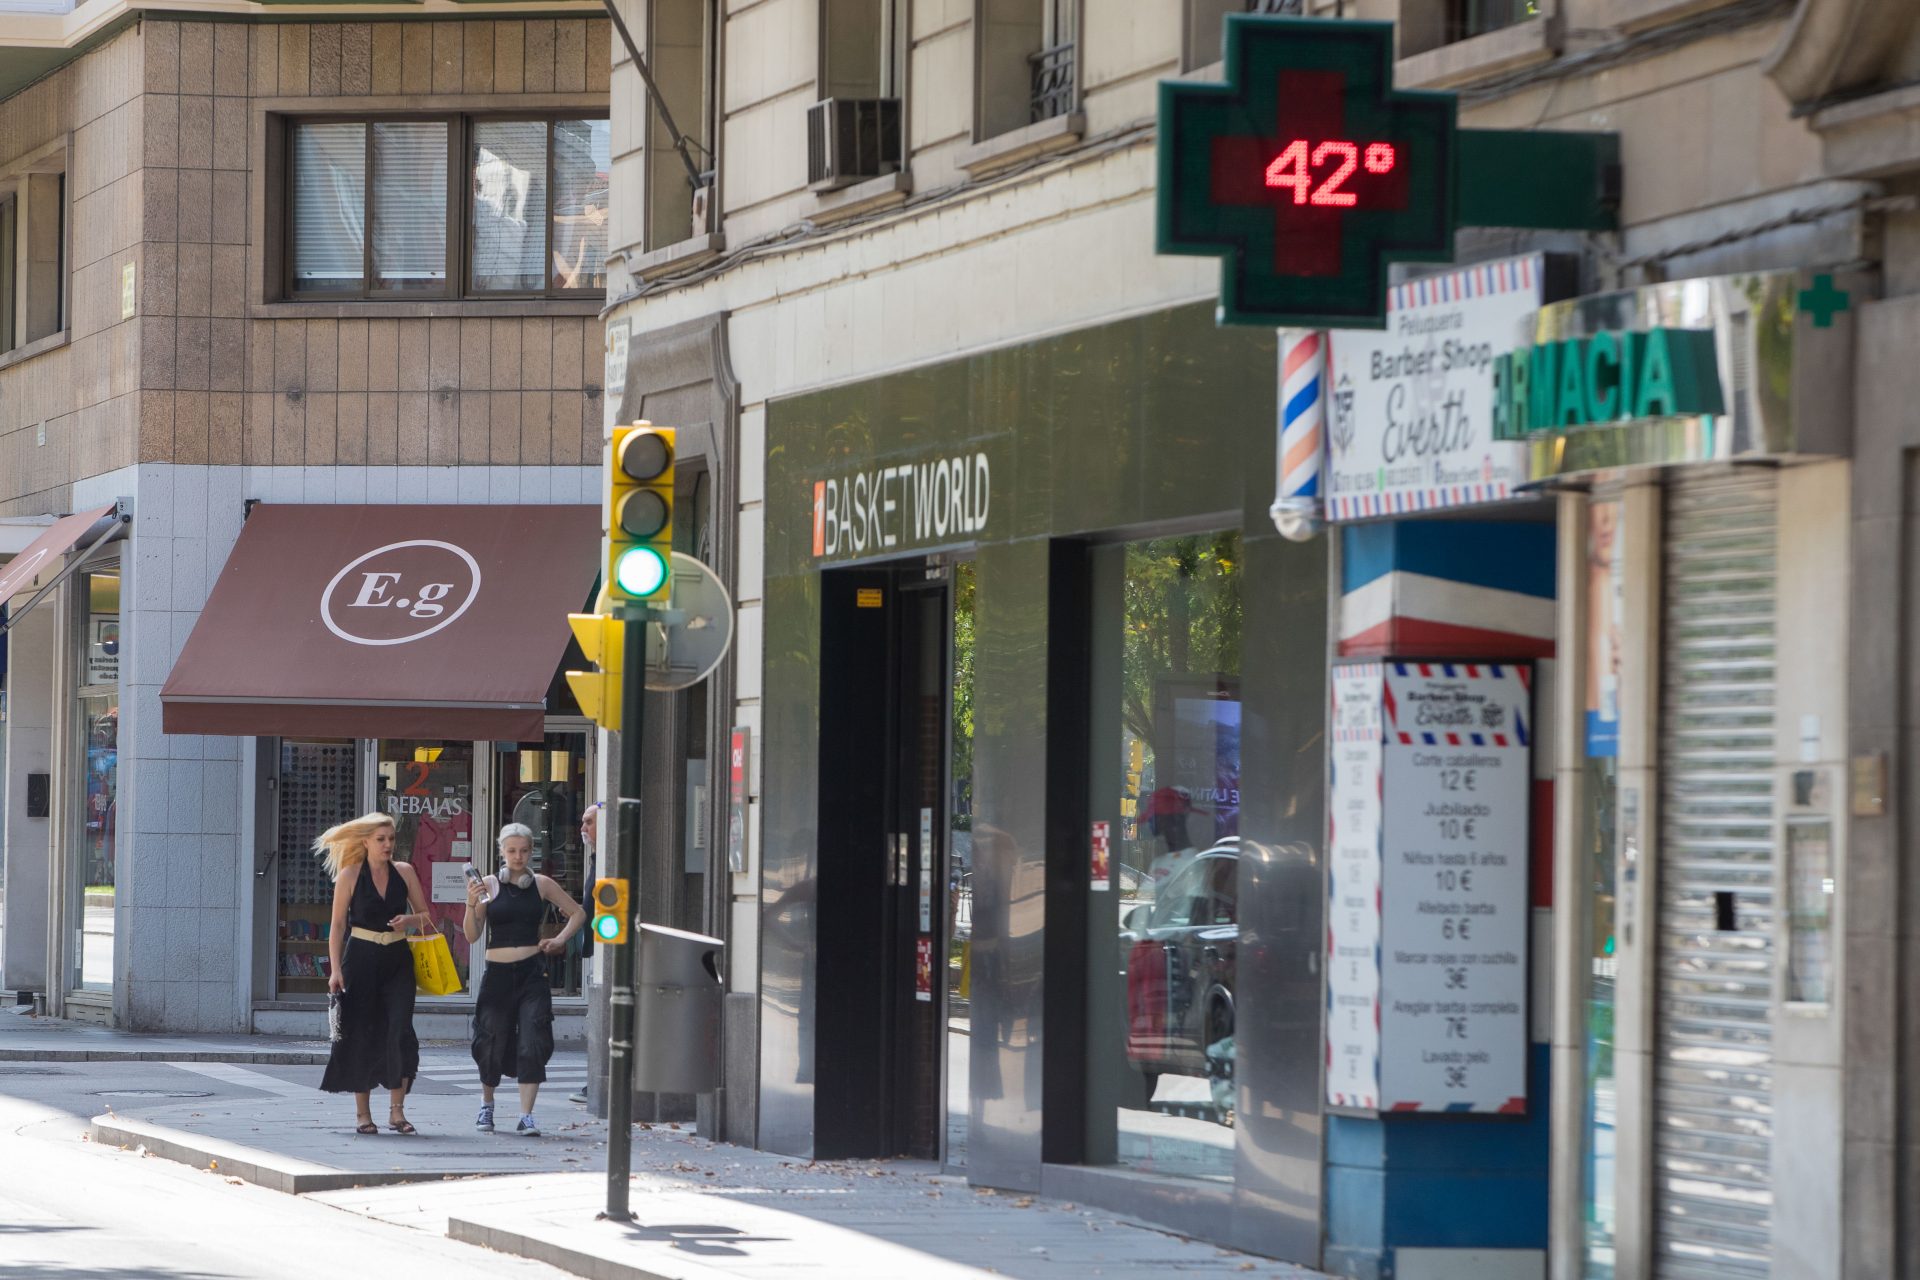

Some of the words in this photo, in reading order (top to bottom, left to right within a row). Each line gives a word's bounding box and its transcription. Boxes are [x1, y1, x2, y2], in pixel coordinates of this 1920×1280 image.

[1371, 346, 1436, 380] Barber
[1442, 338, 1492, 374] Shop
[346, 571, 455, 618] E.g
[1412, 753, 1443, 767] Corte
[1446, 752, 1503, 767] caballeros
[1440, 769, 1461, 791] 12
[387, 795, 463, 818] REBAJAS
[1423, 802, 1491, 817] Jubilado
[1439, 818, 1461, 840] 10
[1435, 870, 1456, 892] 10
[1442, 918, 1455, 940] 6
